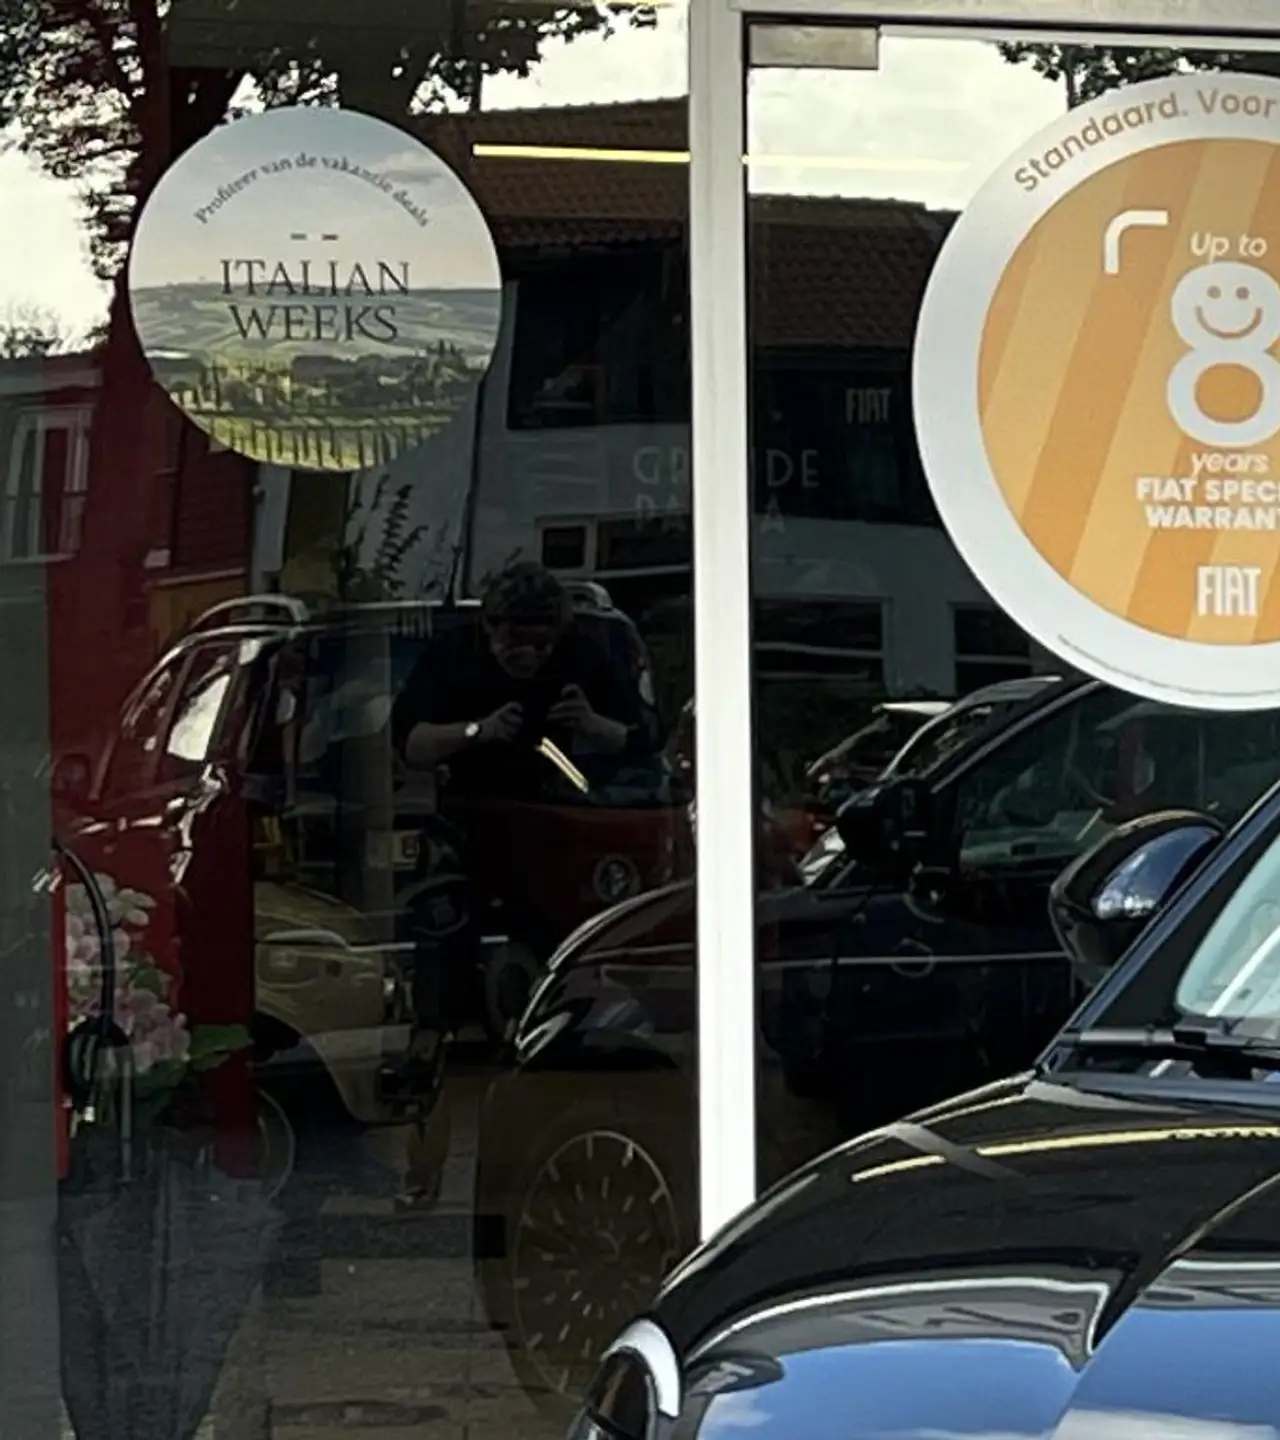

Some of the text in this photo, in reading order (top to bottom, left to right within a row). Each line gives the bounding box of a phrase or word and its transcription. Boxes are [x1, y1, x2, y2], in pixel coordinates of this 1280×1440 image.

[1014, 91, 1189, 191] Standaard.
[1197, 88, 1276, 119] Voor
[194, 152, 428, 228] Profiteer van de vakantie deals
[1190, 231, 1268, 263] Up to
[220, 258, 410, 297] ITALIAN
[229, 304, 398, 344] WEEKS
[633, 446, 820, 489] GRDE
[1190, 450, 1270, 477] years
[1136, 476, 1198, 501] FIAT
[1196, 566, 1262, 617] FIAT
